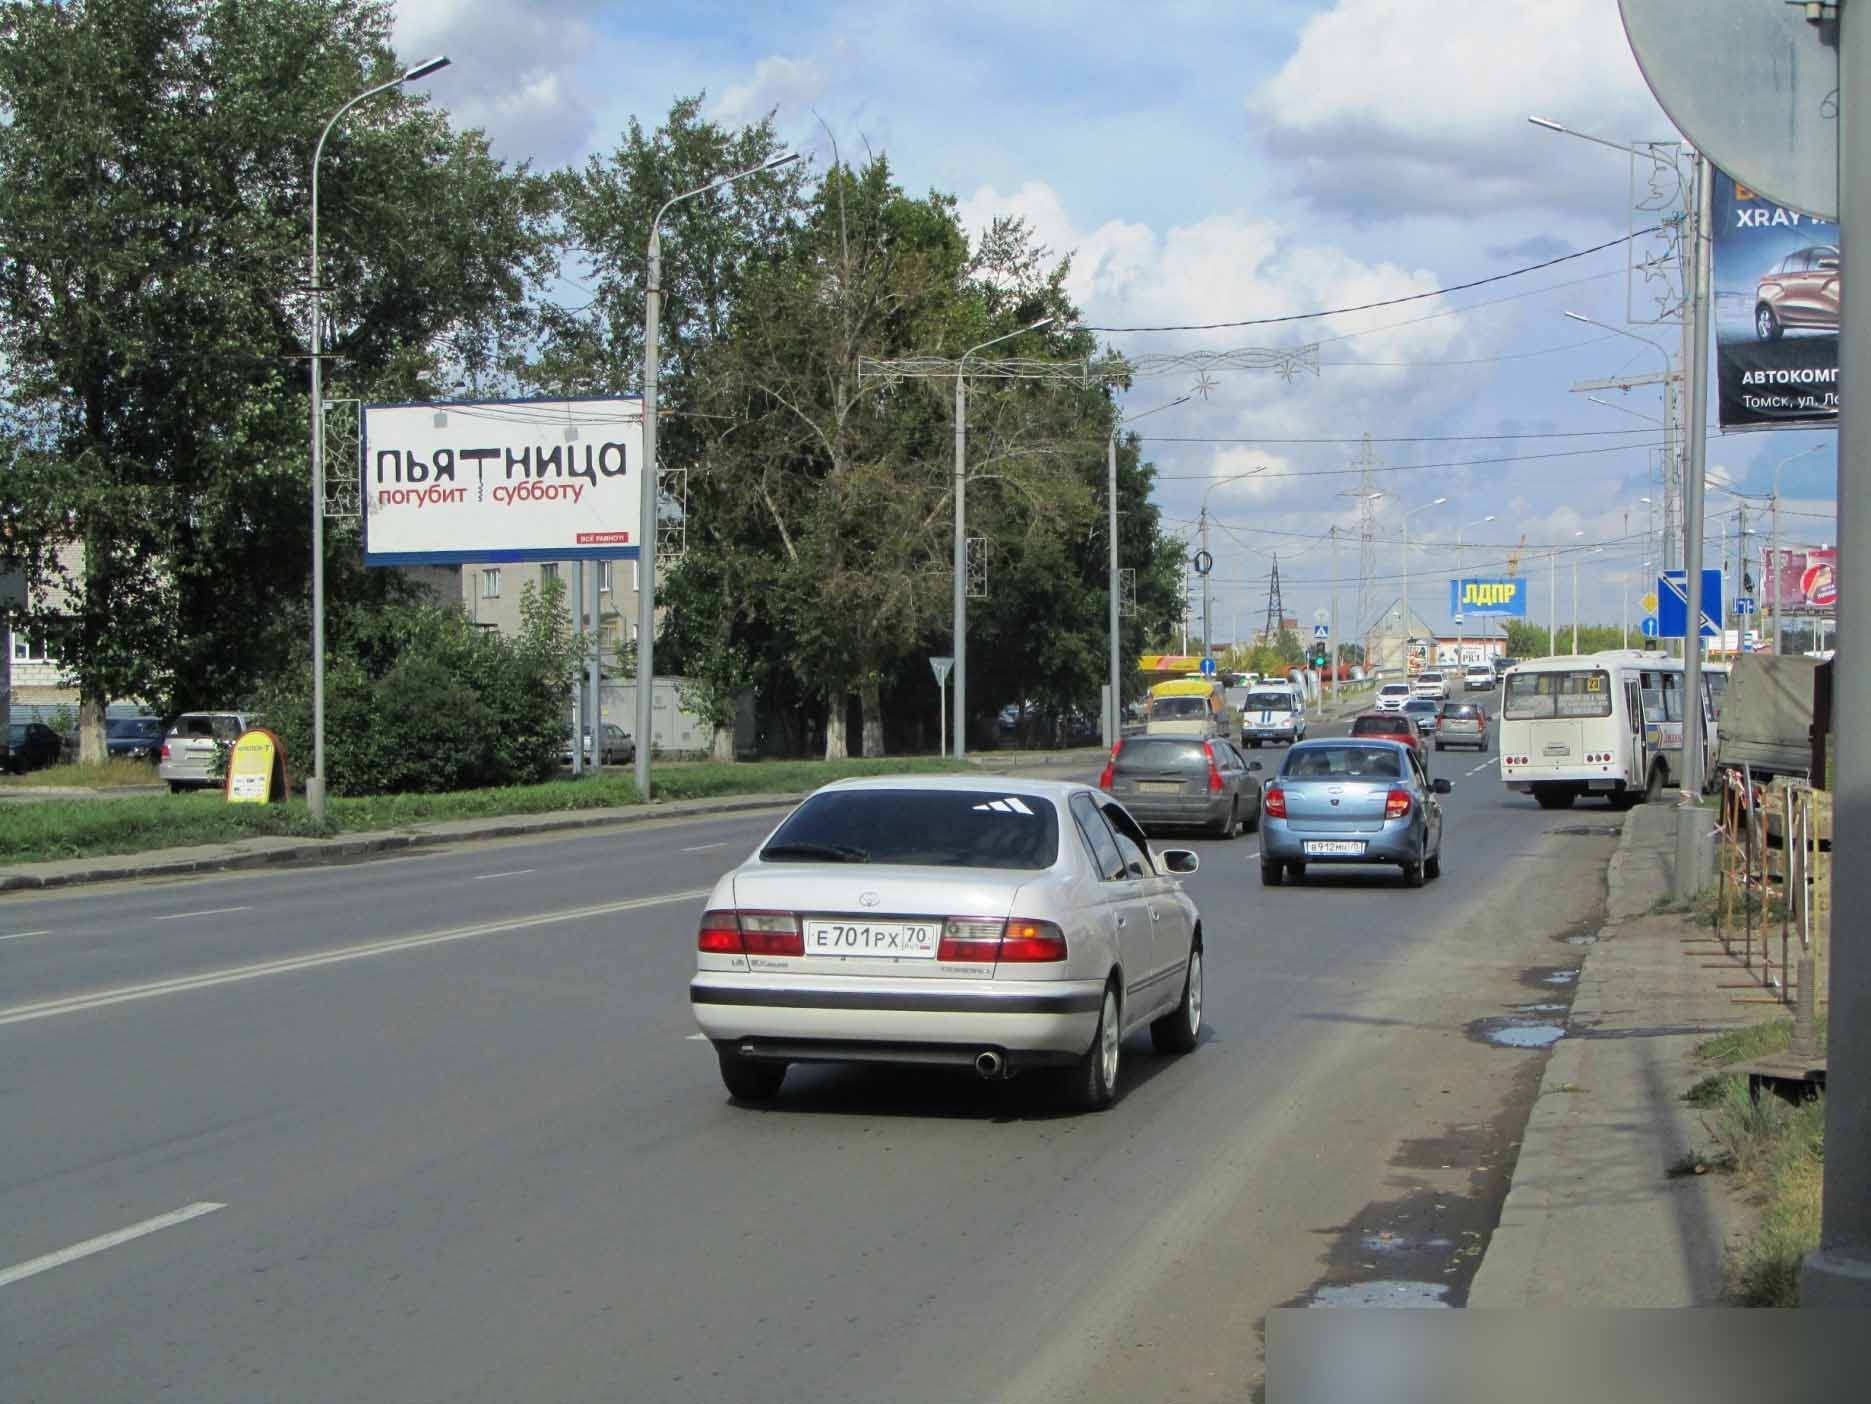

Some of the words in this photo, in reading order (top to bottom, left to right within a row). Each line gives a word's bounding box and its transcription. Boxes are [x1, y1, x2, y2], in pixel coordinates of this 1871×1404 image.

[1736, 208, 1800, 228] XRAY
[1743, 395, 1793, 408] Томск,
[1798, 396, 1818, 408] ул.
[378, 485, 466, 508] погубит
[493, 481, 584, 505] субботу
[1463, 583, 1516, 606] ЛДПР
